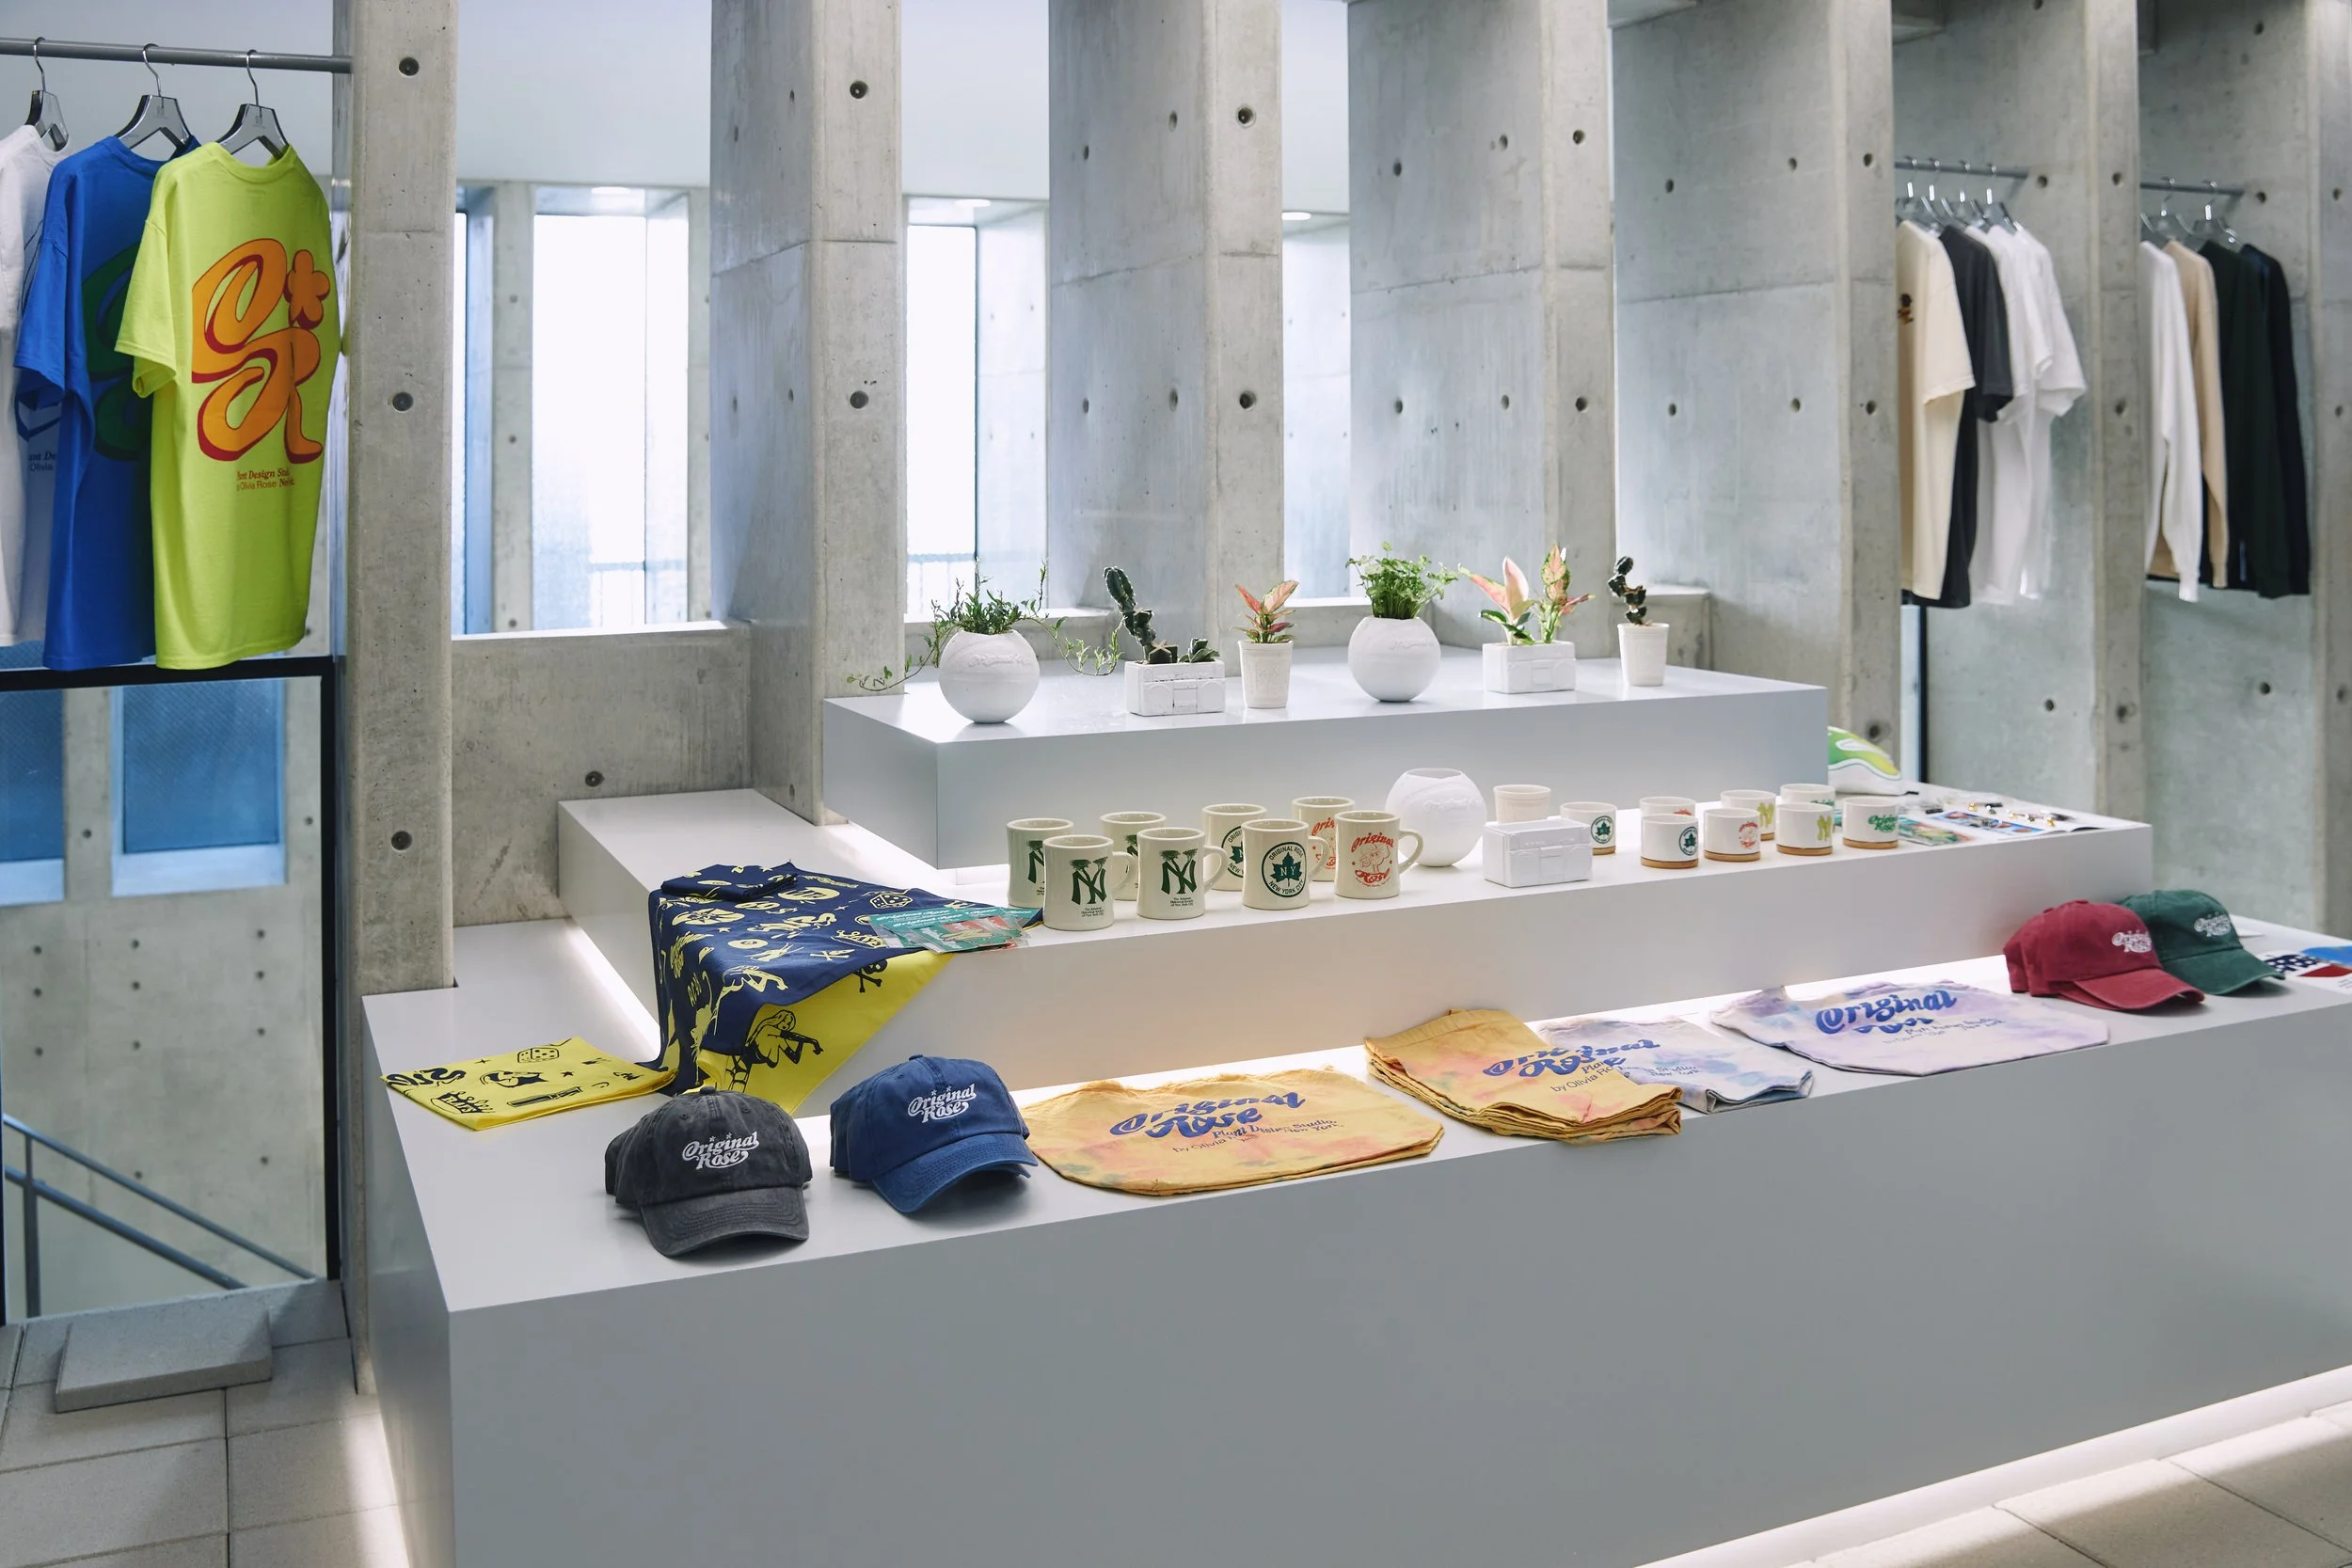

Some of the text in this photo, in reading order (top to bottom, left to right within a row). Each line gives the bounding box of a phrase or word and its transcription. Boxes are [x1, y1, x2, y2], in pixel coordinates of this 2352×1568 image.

[248, 469, 276, 480] Design
[256, 480, 278, 489] Rose
[1268, 846, 1294, 861] ORIGINAL
[1229, 863, 1241, 873] NEW
[1268, 880, 1281, 893] NEW
[1295, 879, 1304, 892] CITY
[1816, 990, 1957, 1035] Original
[1550, 1085, 1567, 1093] by
[1567, 1073, 1597, 1088] Olivia
[907, 1083, 977, 1117] Original
[921, 1101, 969, 1124] Rose
[1109, 1091, 1306, 1136] Original
[1145, 1107, 1263, 1138] Rose
[682, 1132, 760, 1162] Original
[1190, 1138, 1227, 1151] Olivia
[695, 1149, 749, 1170] Rose
